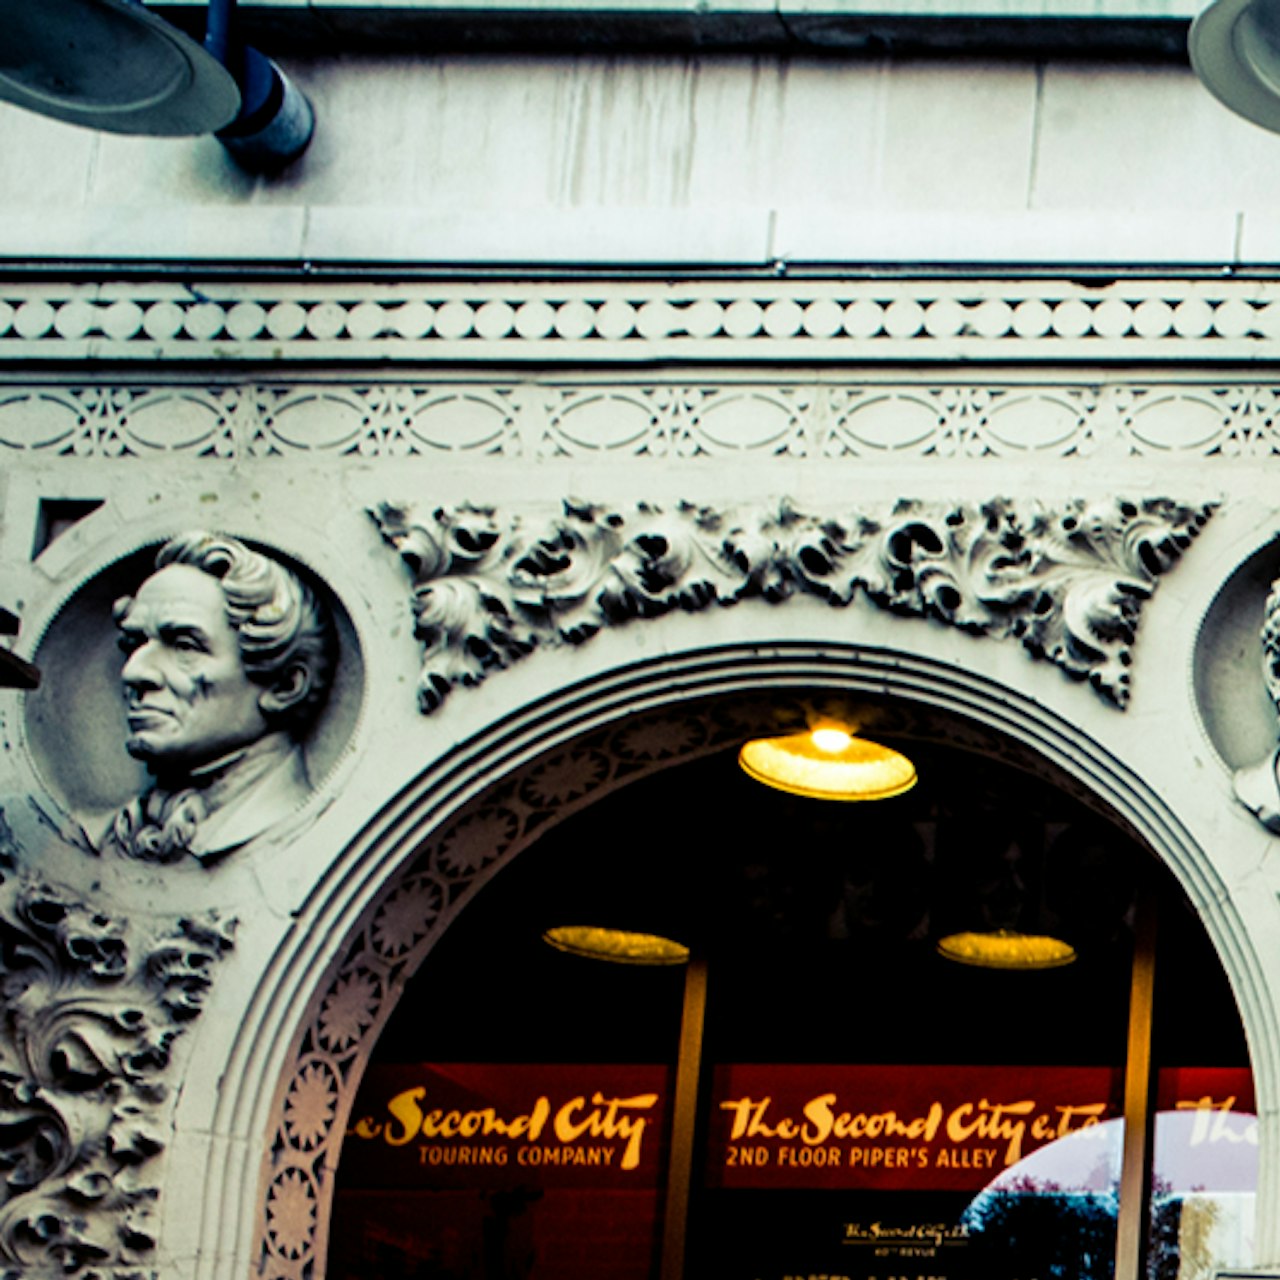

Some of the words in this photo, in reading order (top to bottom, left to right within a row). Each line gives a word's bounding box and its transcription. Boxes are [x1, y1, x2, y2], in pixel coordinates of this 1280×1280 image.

[384, 1086, 551, 1147] Second
[554, 1092, 659, 1171] City
[719, 1096, 799, 1141] The
[799, 1093, 942, 1146] Second
[946, 1099, 1036, 1167] City
[419, 1147, 508, 1167] TOURING
[516, 1147, 615, 1167] COMPANY
[726, 1146, 769, 1167] 2ND
[777, 1146, 841, 1168] FLOOR
[848, 1148, 929, 1168] PIPER'S
[935, 1149, 997, 1168] ALLEY
